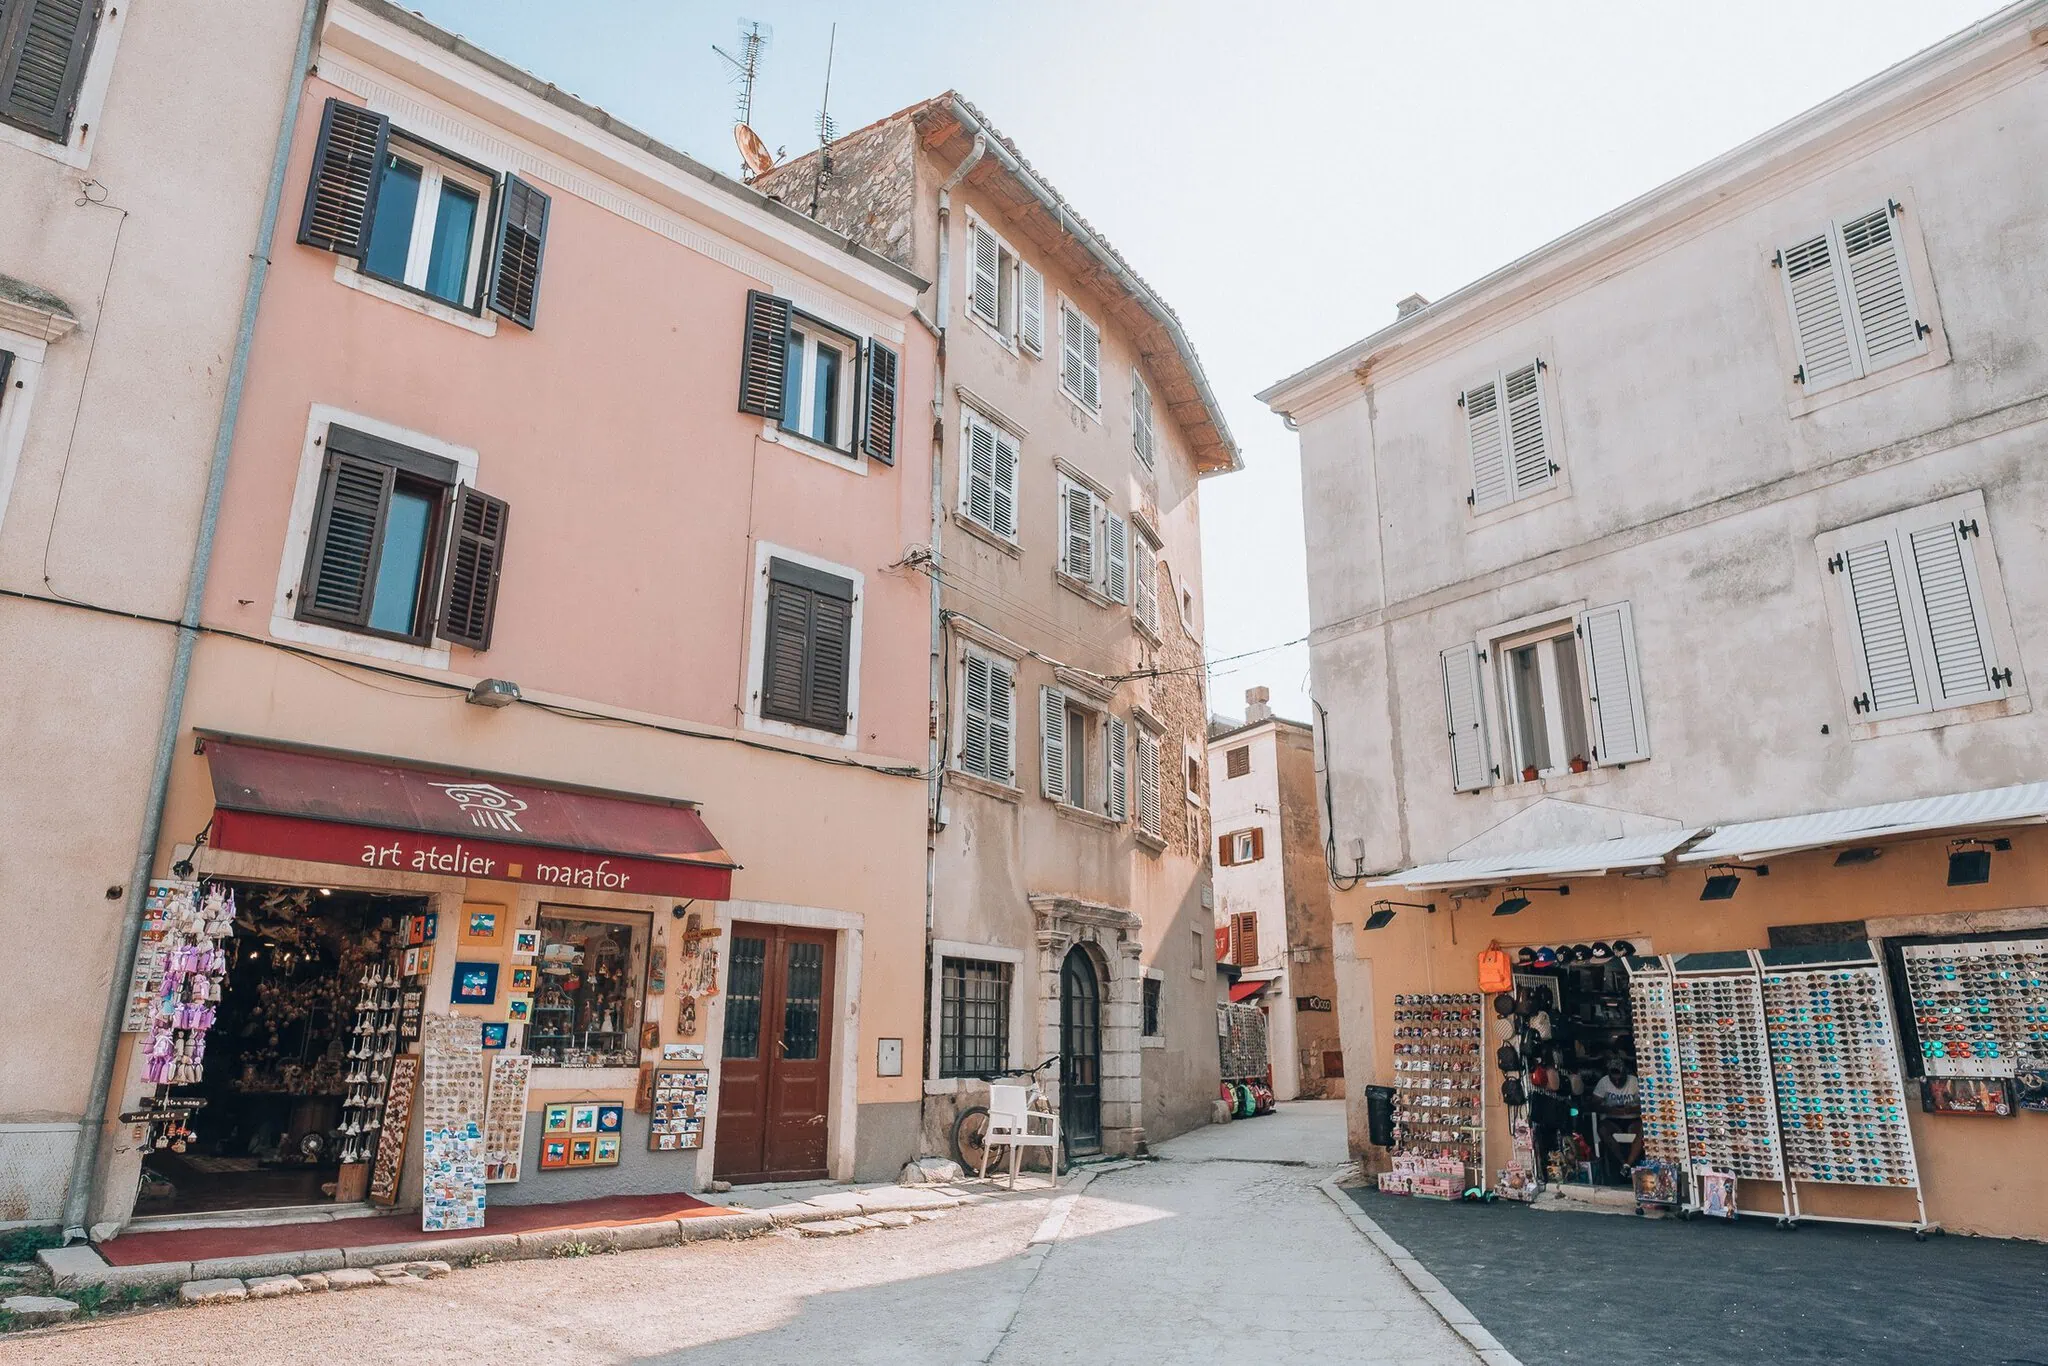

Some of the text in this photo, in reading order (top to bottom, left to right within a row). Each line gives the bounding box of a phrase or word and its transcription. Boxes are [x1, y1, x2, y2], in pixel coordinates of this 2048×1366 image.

[361, 842, 630, 889] art atelier marafor
[1607, 1092, 1636, 1103] TOMMY
